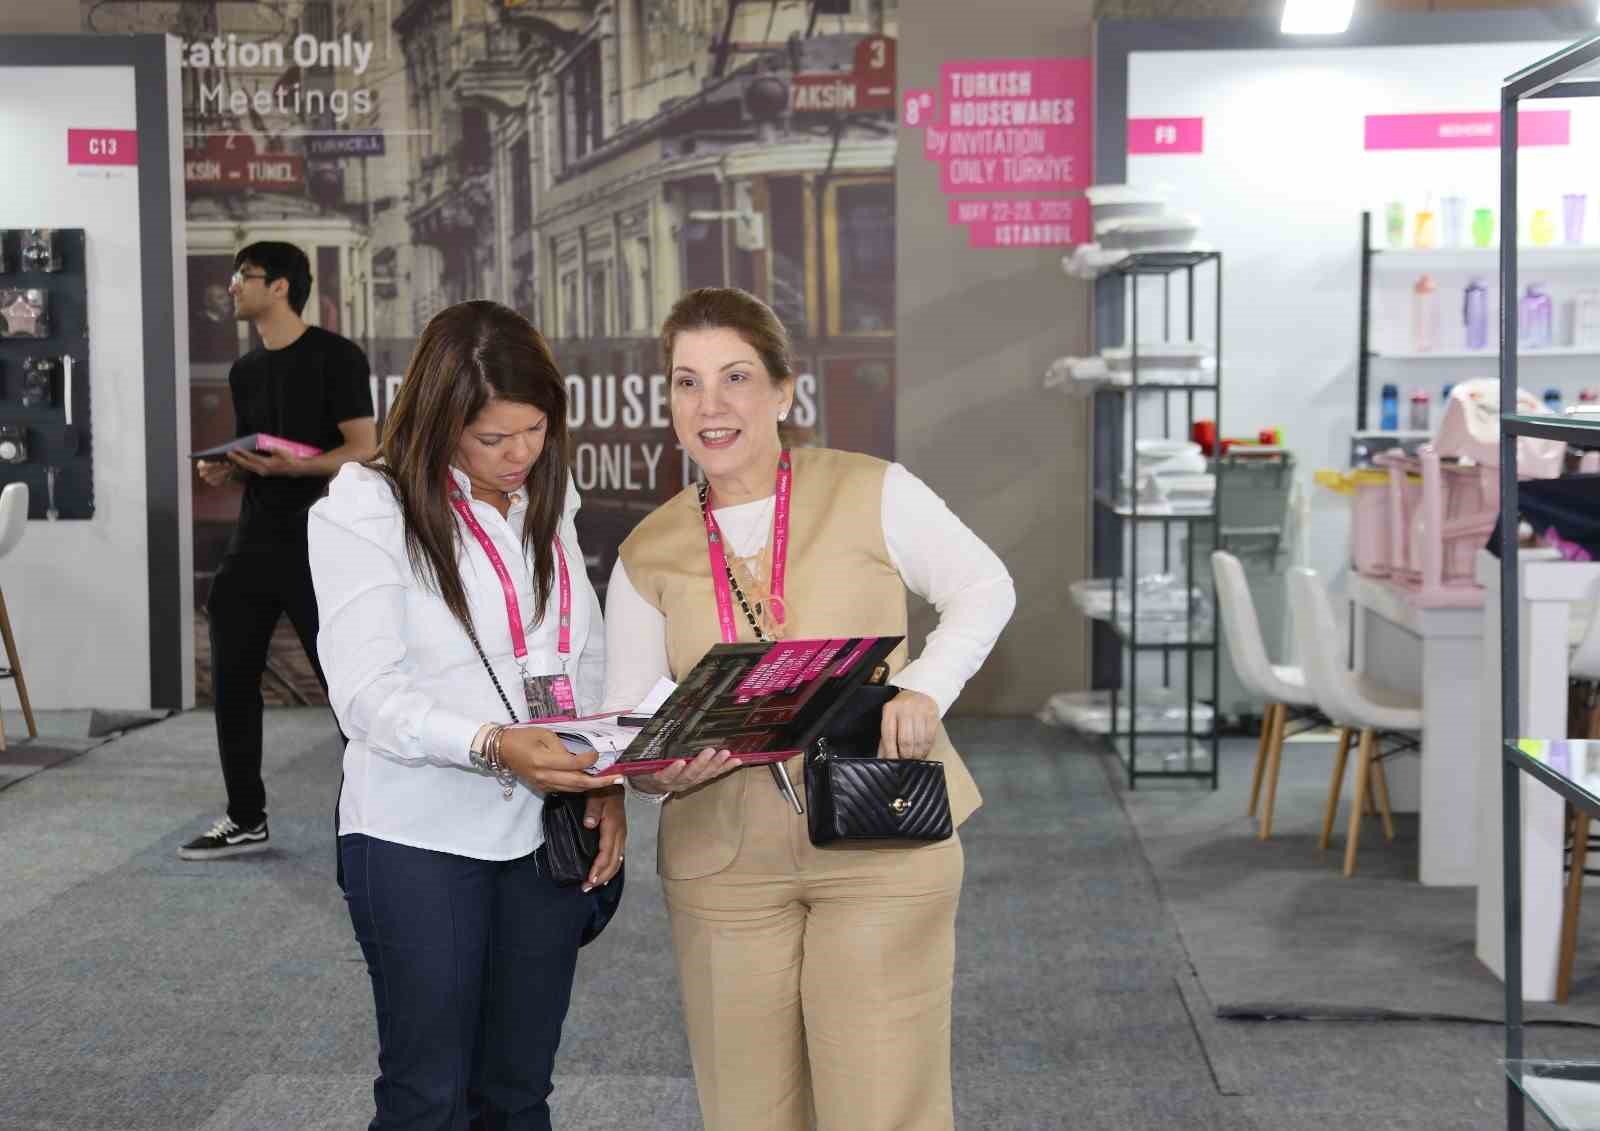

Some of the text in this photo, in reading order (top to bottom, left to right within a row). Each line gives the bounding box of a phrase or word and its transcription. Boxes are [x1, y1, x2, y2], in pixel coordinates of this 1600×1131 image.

[293, 33, 374, 75] Only
[870, 40, 886, 69] 3
[950, 72, 1032, 97] TURKISH
[199, 82, 371, 122] Meetings
[949, 98, 1075, 126] HOUSEWARES
[89, 138, 117, 155] C13
[926, 129, 1046, 156] by INVITATION
[950, 158, 998, 184] ONLY
[576, 442, 664, 490] ONLY
